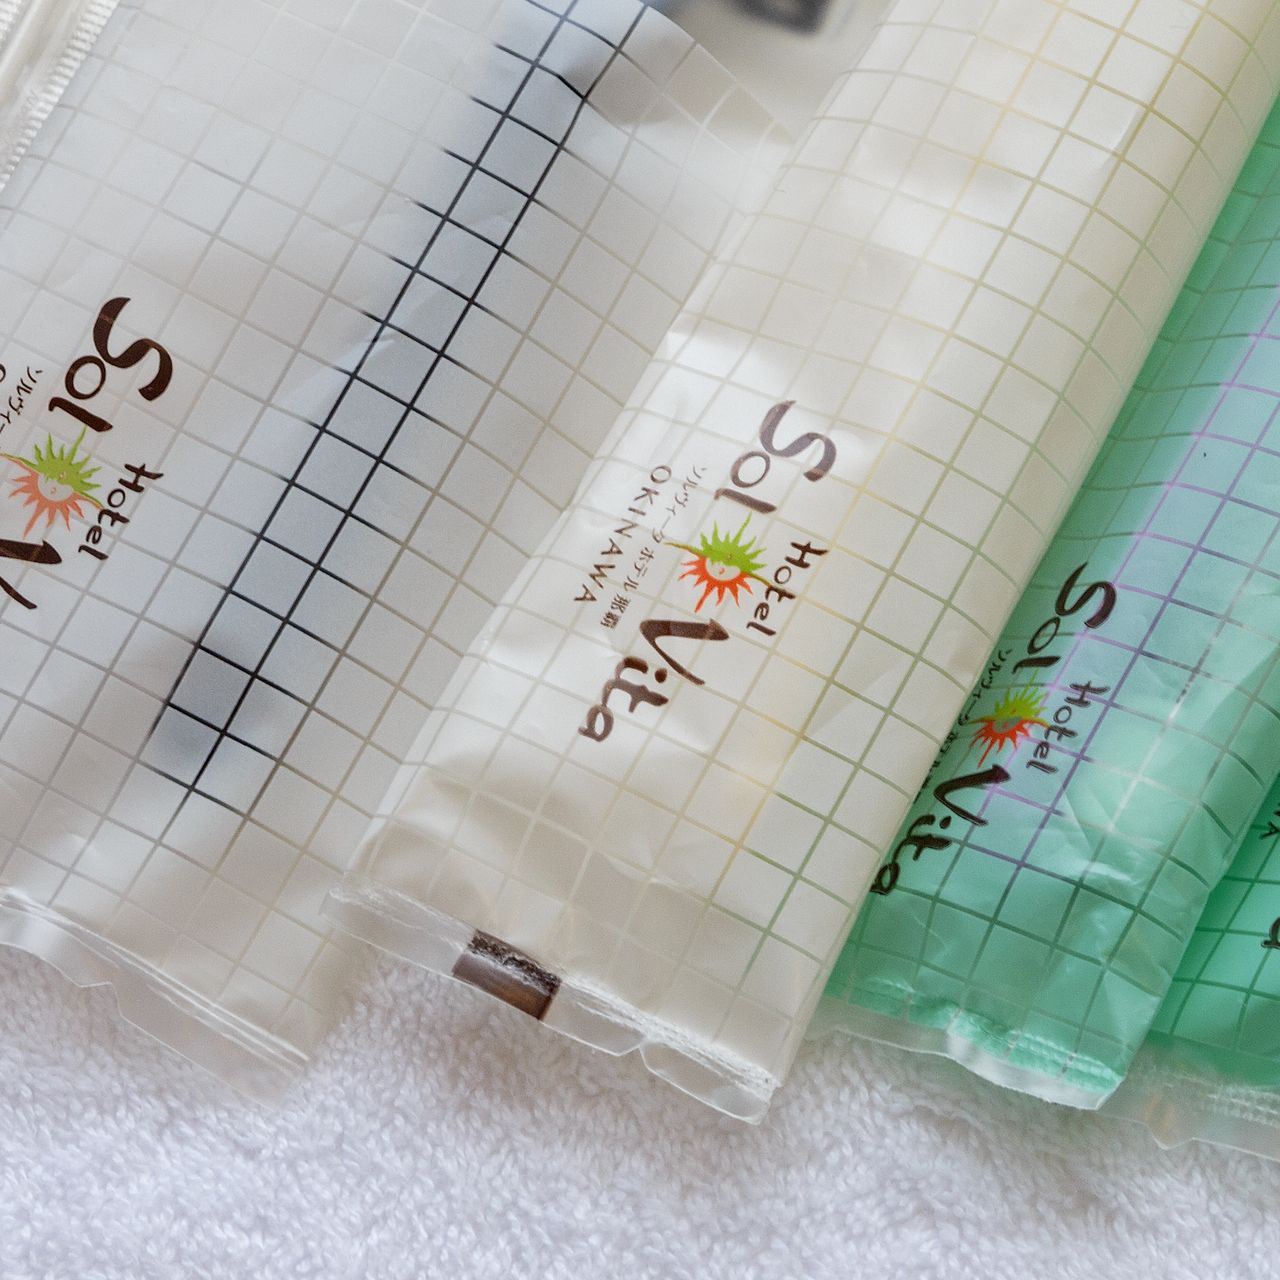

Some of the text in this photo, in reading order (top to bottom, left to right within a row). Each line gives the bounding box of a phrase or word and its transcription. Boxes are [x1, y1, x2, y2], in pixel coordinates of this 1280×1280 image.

[49, 297, 173, 432] Sol
[78, 463, 164, 560] Hotel
[574, 465, 672, 602] OKINAWA
[578, 400, 836, 742] Sol Vita
[746, 541, 829, 636] Hotel
[871, 562, 1116, 895] Sol Vita
[1027, 681, 1110, 773] Hotel
